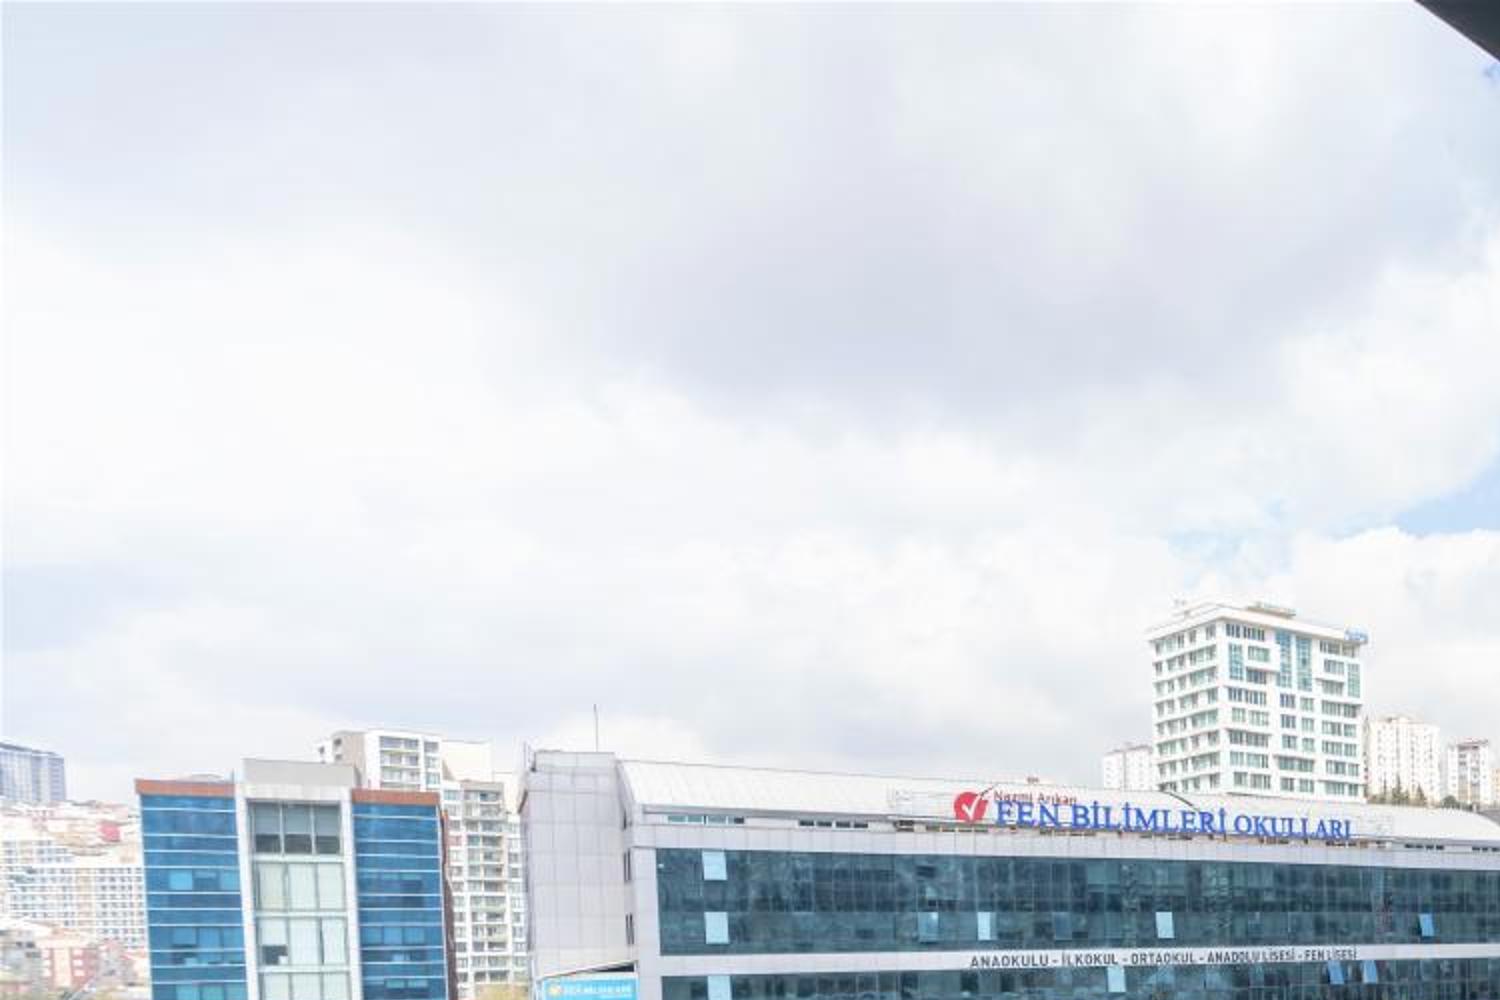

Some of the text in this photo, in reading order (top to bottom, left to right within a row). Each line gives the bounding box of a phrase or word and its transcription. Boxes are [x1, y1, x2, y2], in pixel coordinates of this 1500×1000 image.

[996, 799, 1352, 839] FEN BİLİMLERİ OKULLARI
[970, 955, 1049, 968] ANAOKULU
[1061, 952, 1118, 966] İLKOKUL
[1131, 952, 1195, 965] ORTAOKUL
